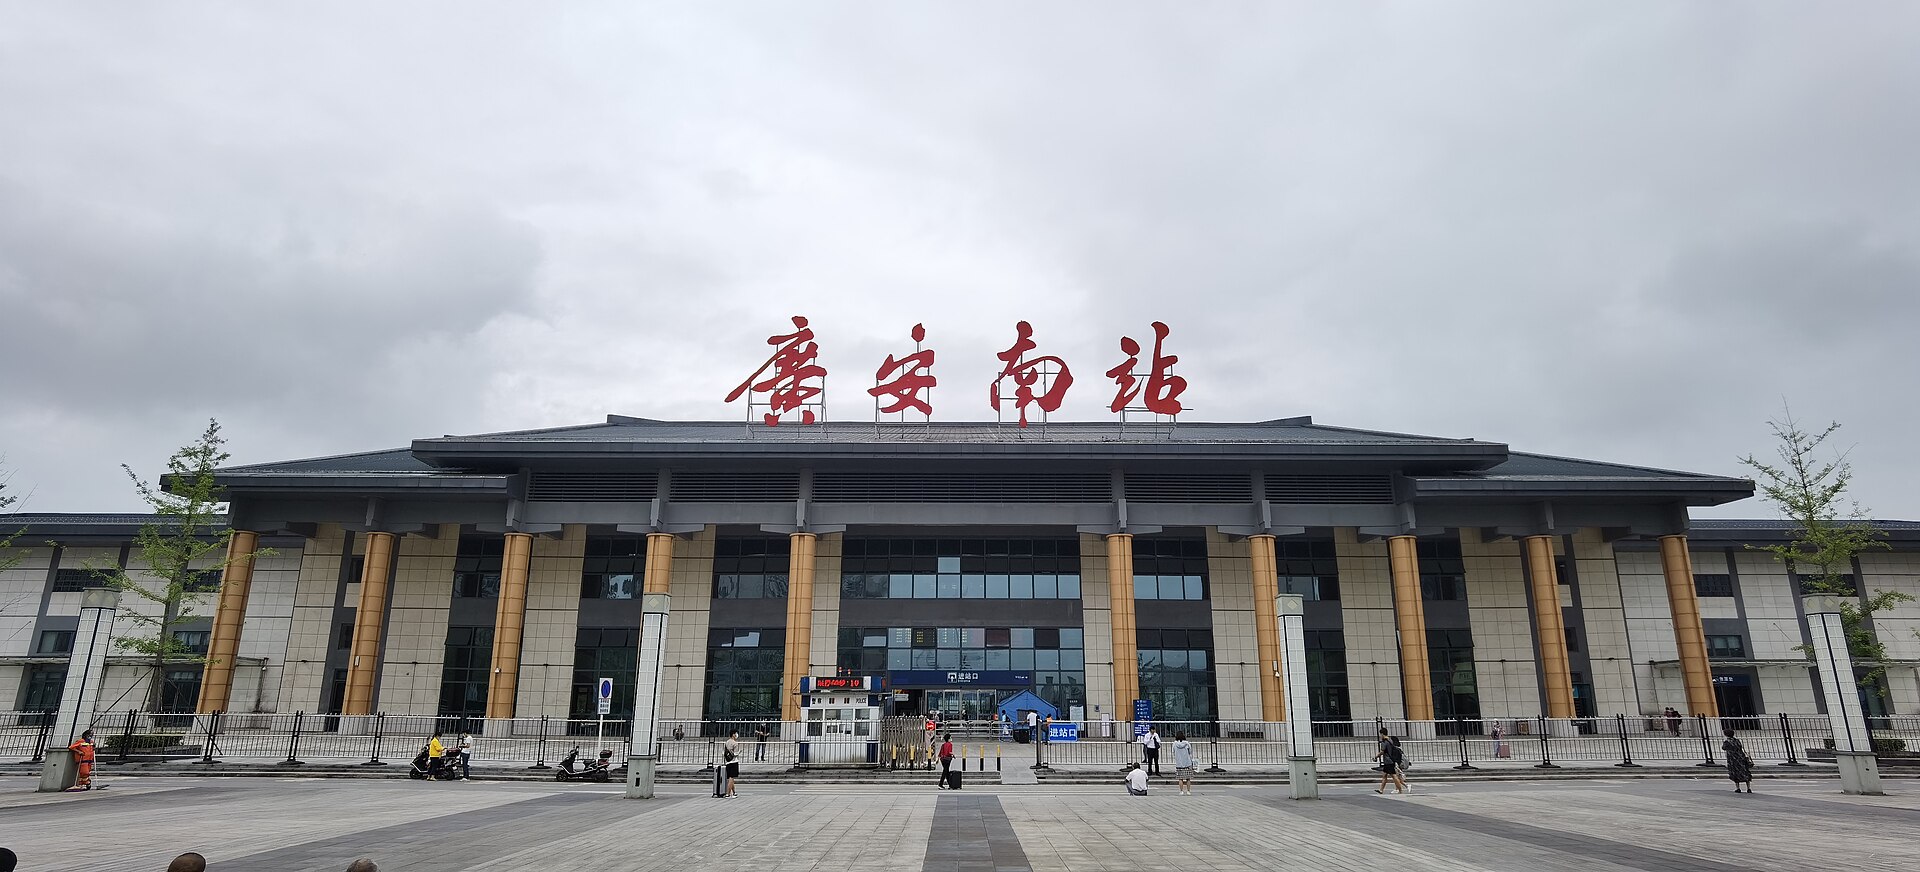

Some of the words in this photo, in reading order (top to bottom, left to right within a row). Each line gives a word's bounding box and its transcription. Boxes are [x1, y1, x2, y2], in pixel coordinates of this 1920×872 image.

[957, 672, 979, 680] 进站口
[1049, 727, 1076, 738] 进站口
